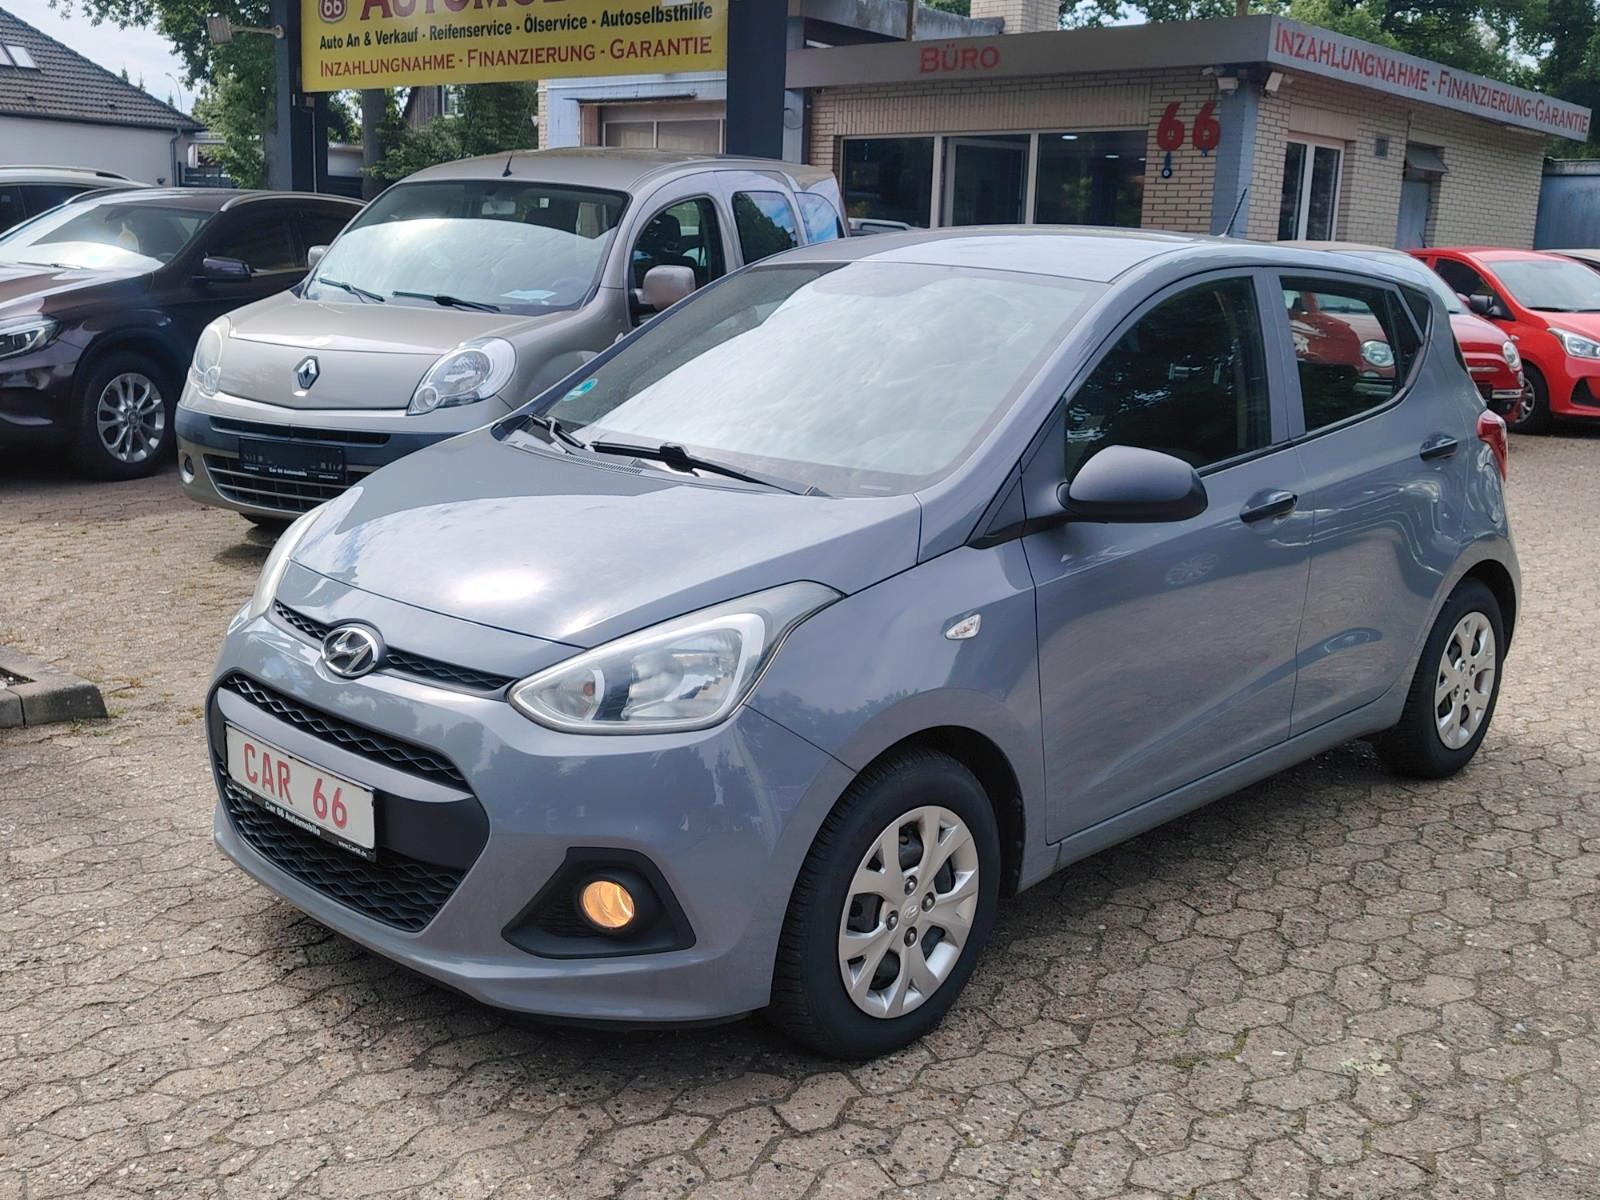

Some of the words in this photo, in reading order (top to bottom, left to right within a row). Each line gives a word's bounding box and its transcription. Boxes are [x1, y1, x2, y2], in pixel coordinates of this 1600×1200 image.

[320, 35, 343, 50] Auto
[347, 33, 360, 48] An
[364, 31, 371, 46] &
[375, 27, 418, 45] Verkauf
[429, 20, 512, 41] Reifenservice
[524, 14, 587, 34] Ölservice
[600, 2, 713, 28] Autoselbsthilfe
[320, 53, 455, 77] INZAHLUNGNAHME
[467, 44, 595, 67] FINANZIERUNG
[610, 36, 712, 60] GARANTIE
[920, 43, 1000, 73] BÜRO
[1274, 23, 1430, 91] INZAHLUNGNAHME
[243, 743, 293, 805] CAR
[312, 778, 348, 829] 66
[265, 801, 276, 812] Car
[285, 810, 320, 836] Automobile
